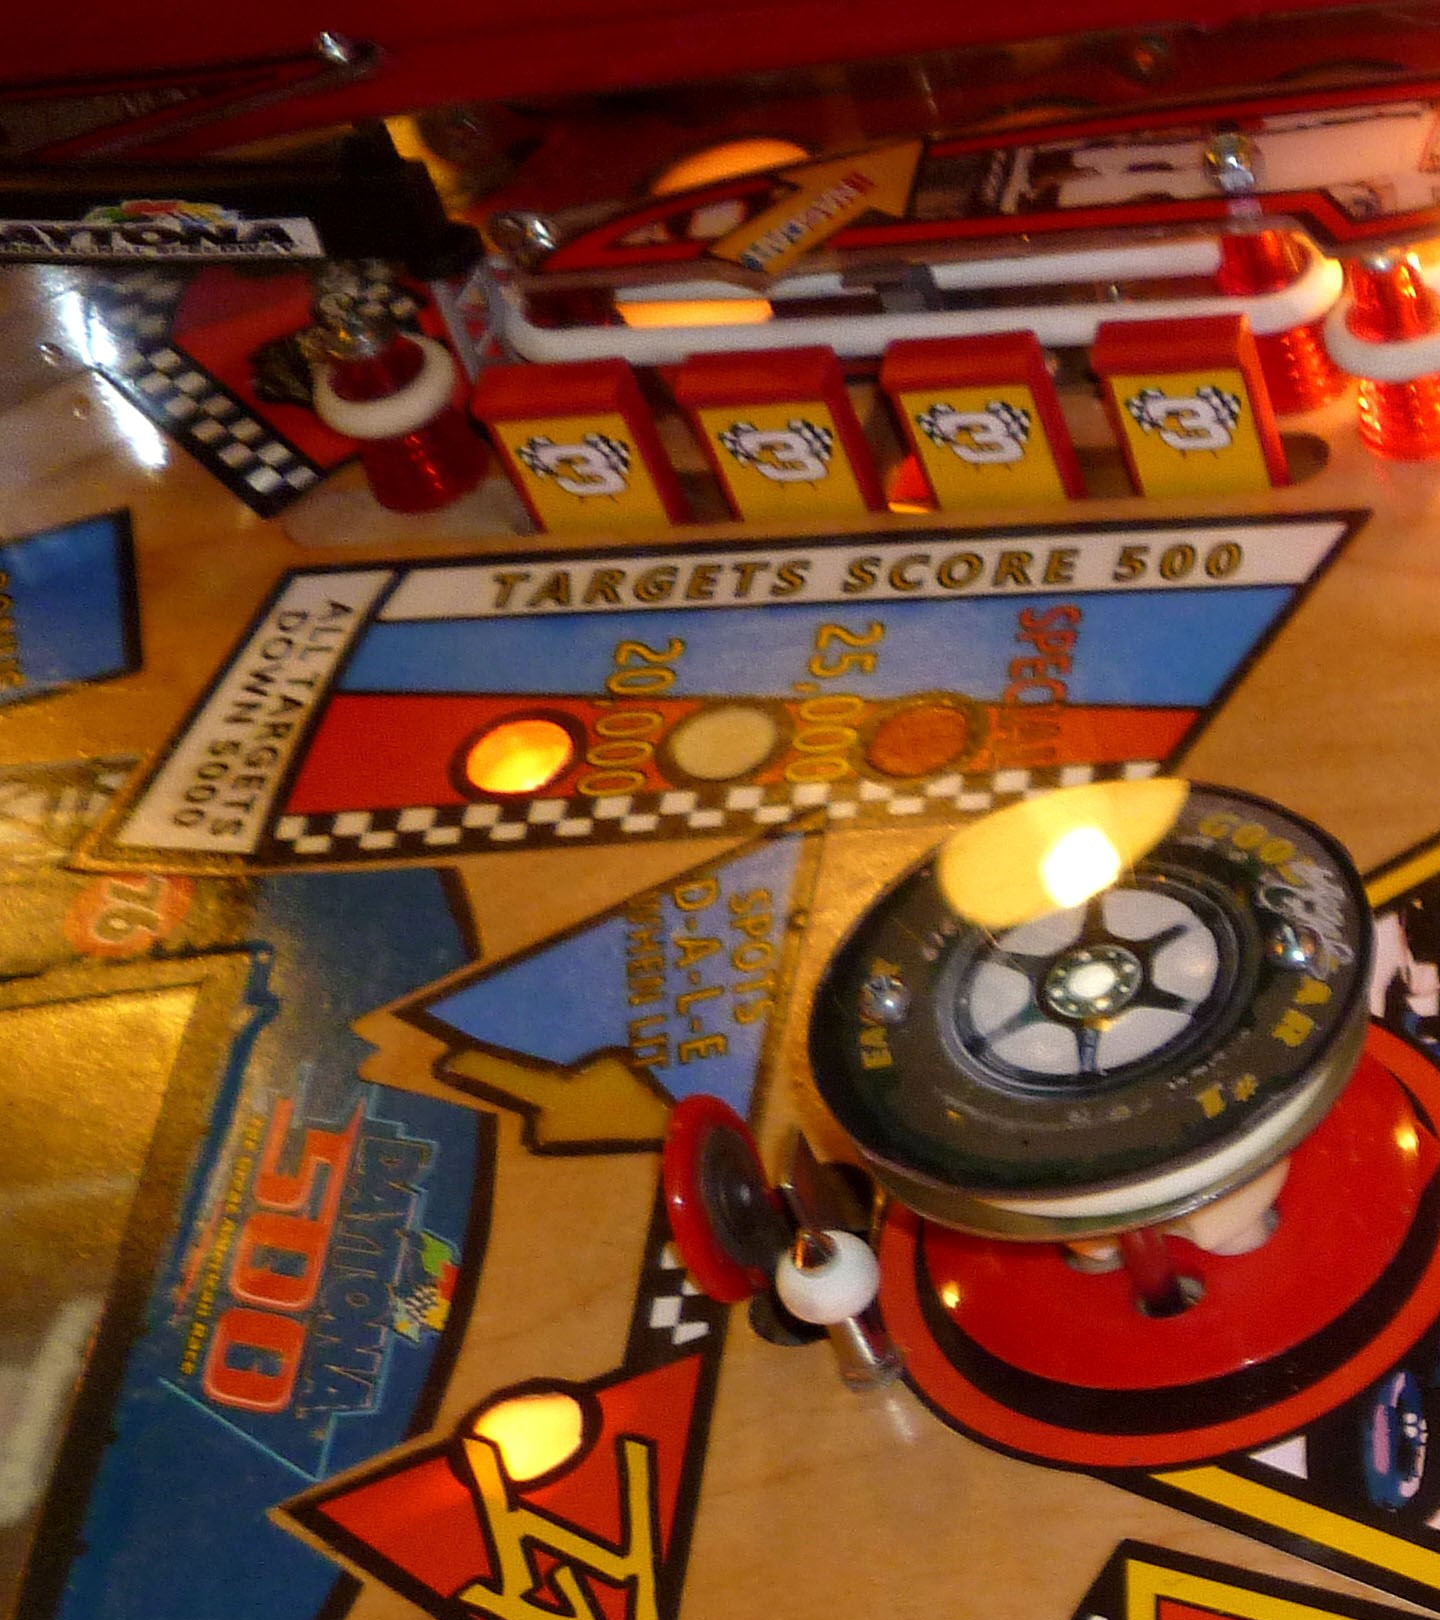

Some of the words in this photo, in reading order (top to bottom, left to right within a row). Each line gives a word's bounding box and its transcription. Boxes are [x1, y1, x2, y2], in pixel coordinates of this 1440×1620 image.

[745, 428, 824, 484] 3
[942, 410, 1022, 465] 3
[1151, 389, 1236, 452] 3
[550, 445, 625, 497] 3
[490, 559, 810, 611] TARGETS
[841, 547, 1082, 595] SCORE
[1112, 542, 1245, 584] 500
[225, 609, 309, 724] DOWN
[296, 600, 353, 662] ALL
[577, 636, 686, 798] 20,000
[784, 621, 886, 785] 25,000
[174, 738, 241, 829] 5000
[210, 671, 316, 836] TARGETS
[728, 888, 775, 1026] SPOTS
[203, 1096, 366, 1414] 500
